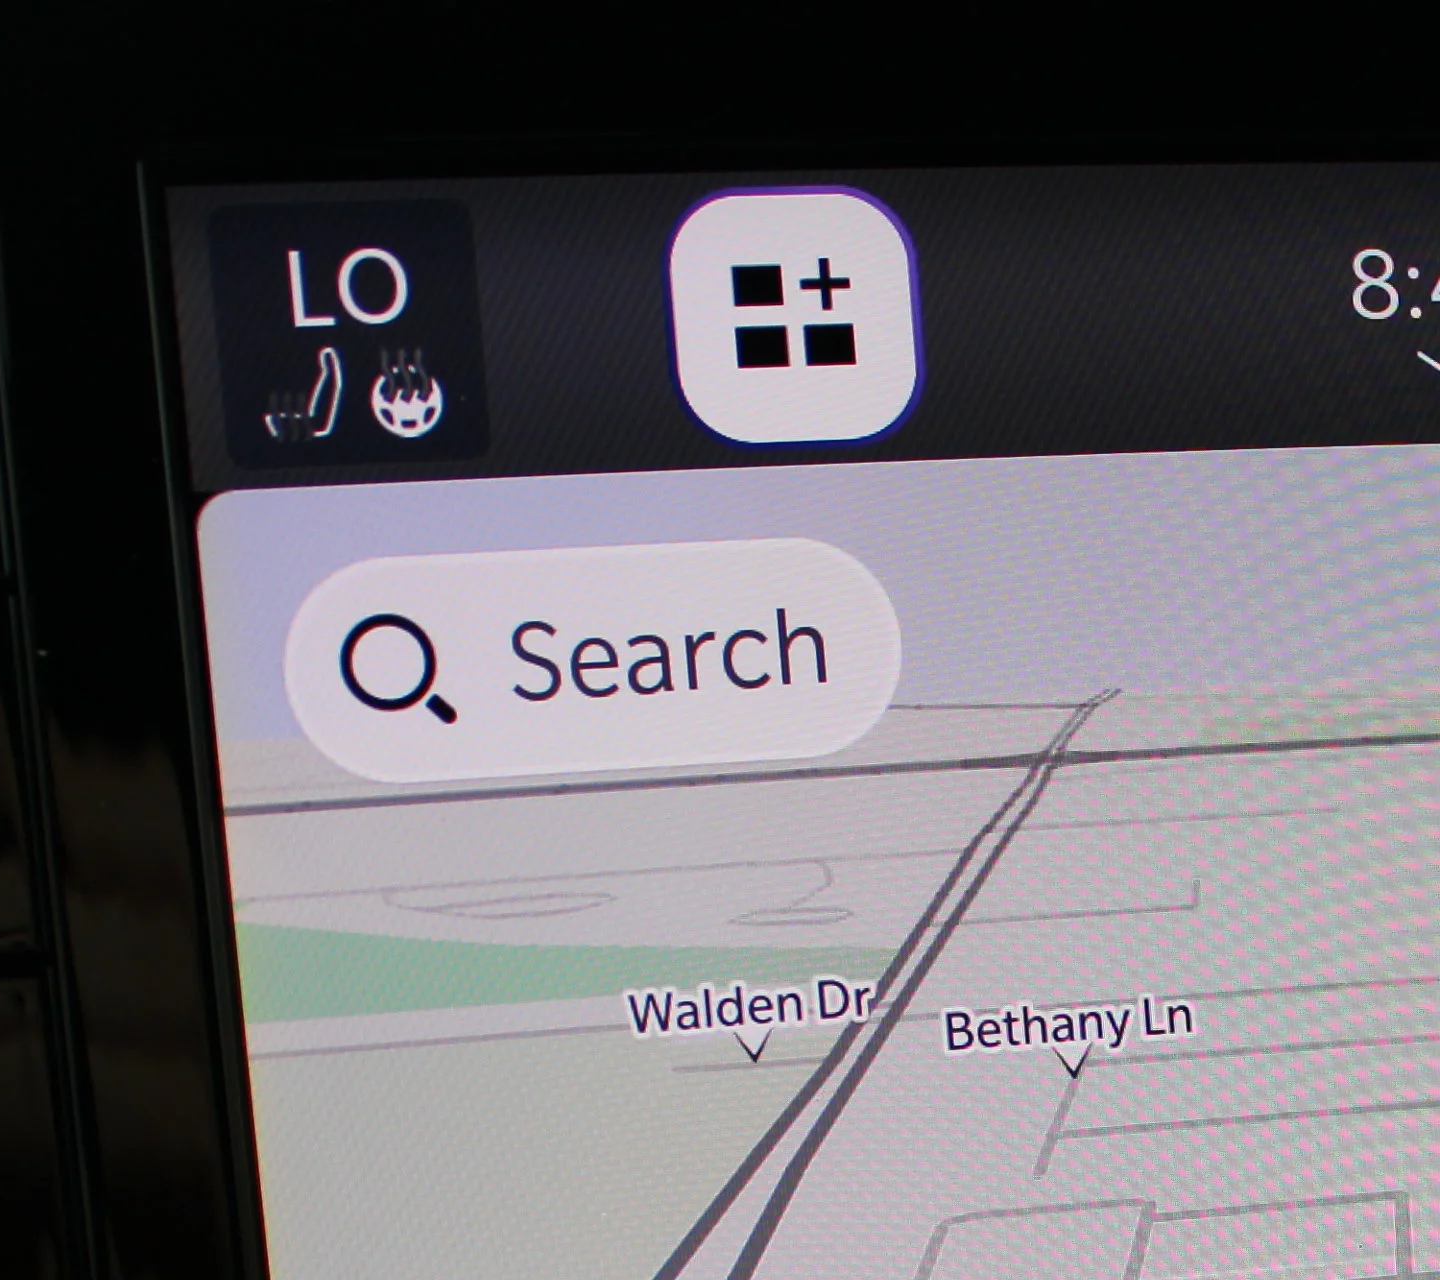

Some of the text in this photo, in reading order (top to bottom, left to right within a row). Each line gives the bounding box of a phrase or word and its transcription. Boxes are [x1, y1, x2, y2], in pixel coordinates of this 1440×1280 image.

[286, 247, 409, 328] LO
[509, 607, 829, 702] Search
[628, 979, 873, 1034] Walden Dr
[946, 996, 1194, 1051] Bethany Ln
